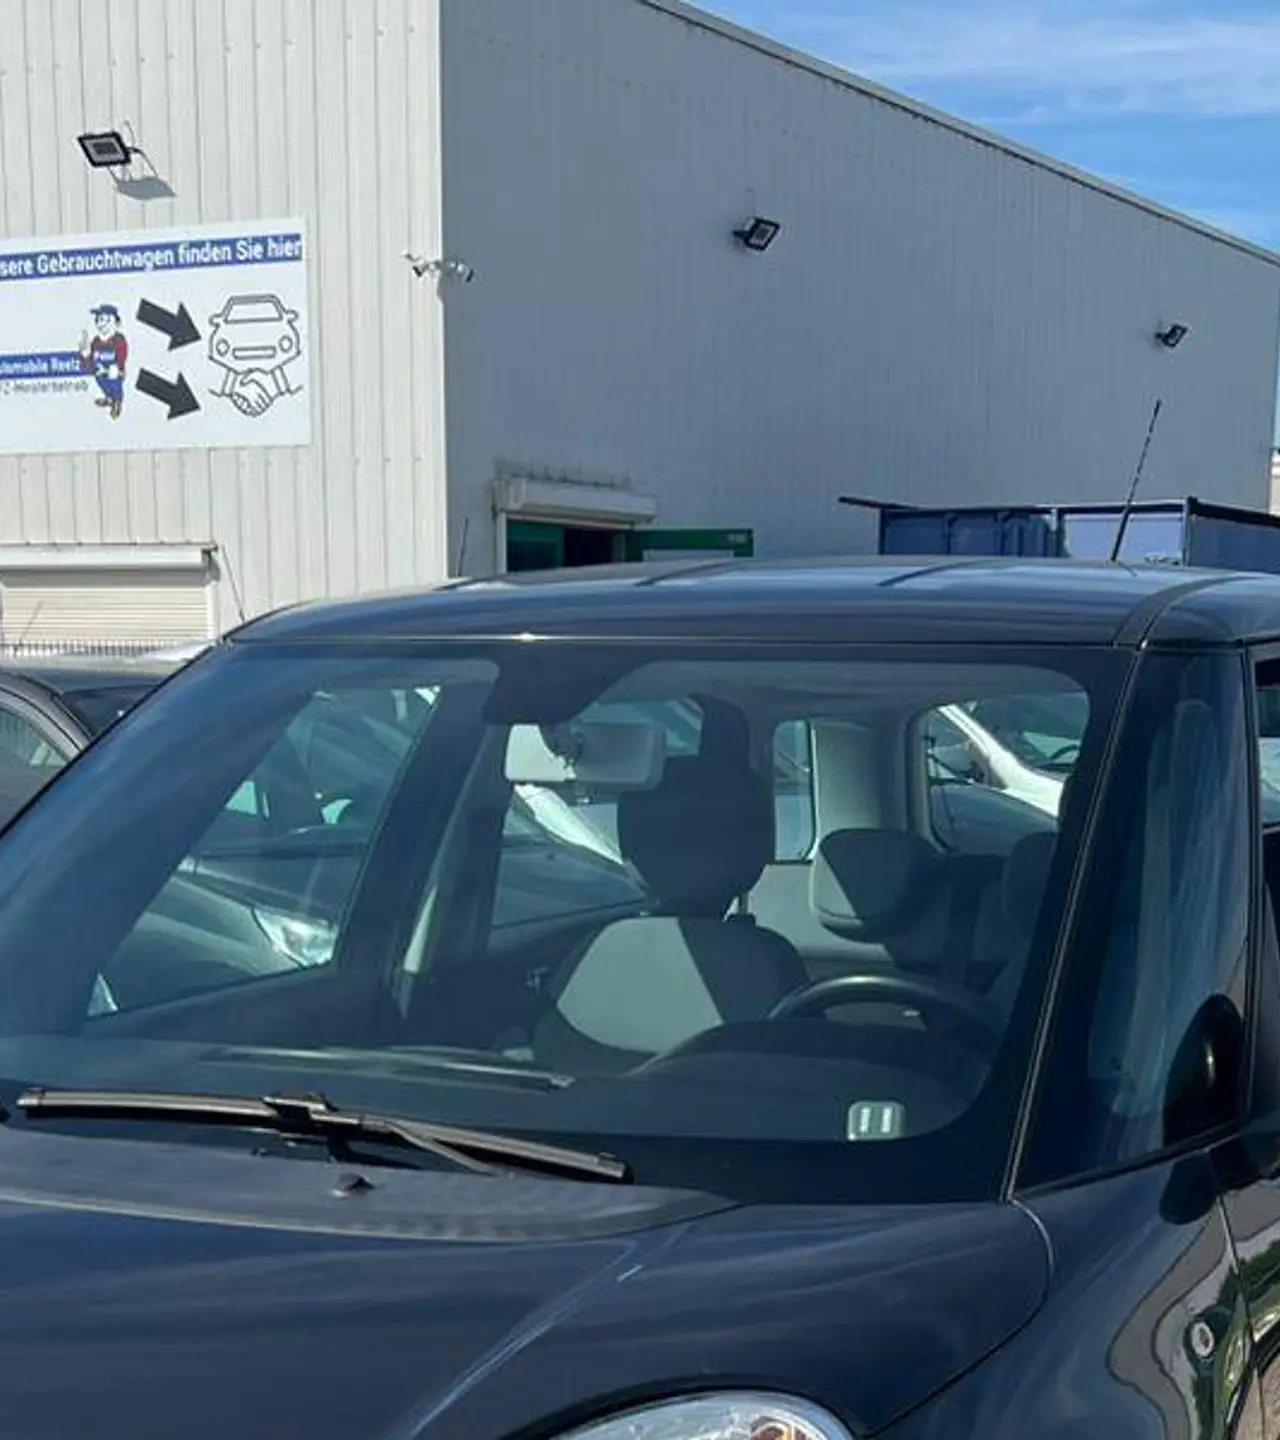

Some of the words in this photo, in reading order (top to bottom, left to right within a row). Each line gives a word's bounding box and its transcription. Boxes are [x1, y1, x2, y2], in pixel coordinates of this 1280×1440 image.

[37, 248, 174, 275] Gebrauchtwagen
[178, 241, 232, 264] finden
[236, 238, 263, 261] Sie
[267, 236, 301, 258] hier
